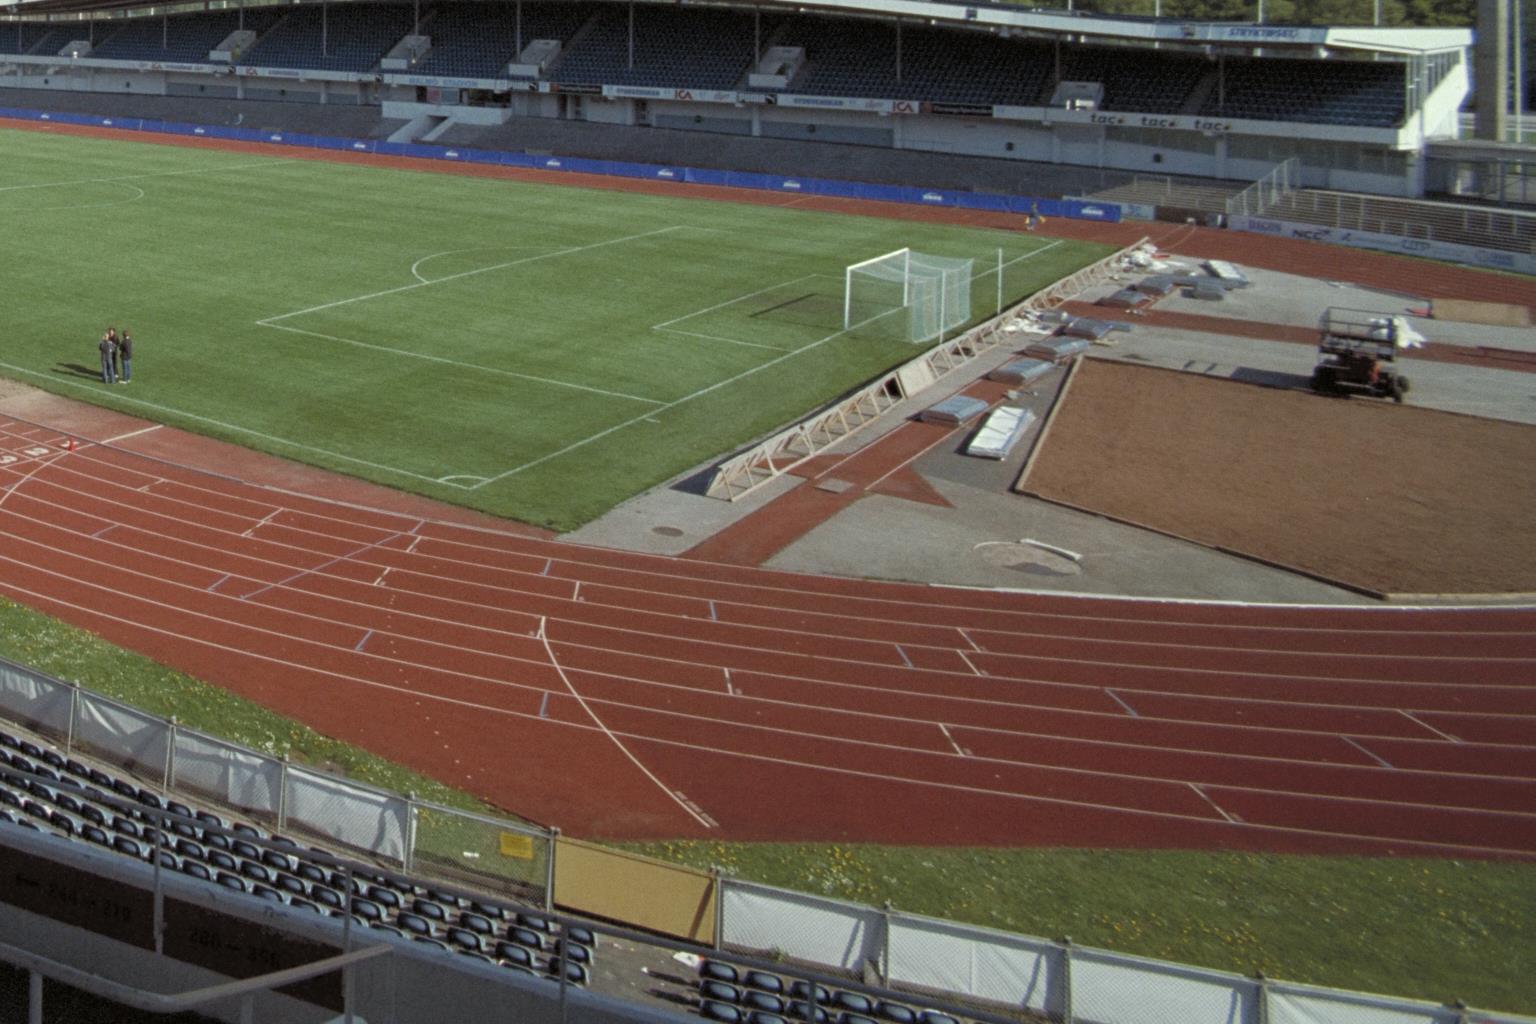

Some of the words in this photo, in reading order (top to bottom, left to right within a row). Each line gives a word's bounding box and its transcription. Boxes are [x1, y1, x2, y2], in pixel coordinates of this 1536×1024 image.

[675, 89, 693, 100] ICA
[892, 101, 913, 112] ICA
[1292, 230, 1322, 241] NCC
